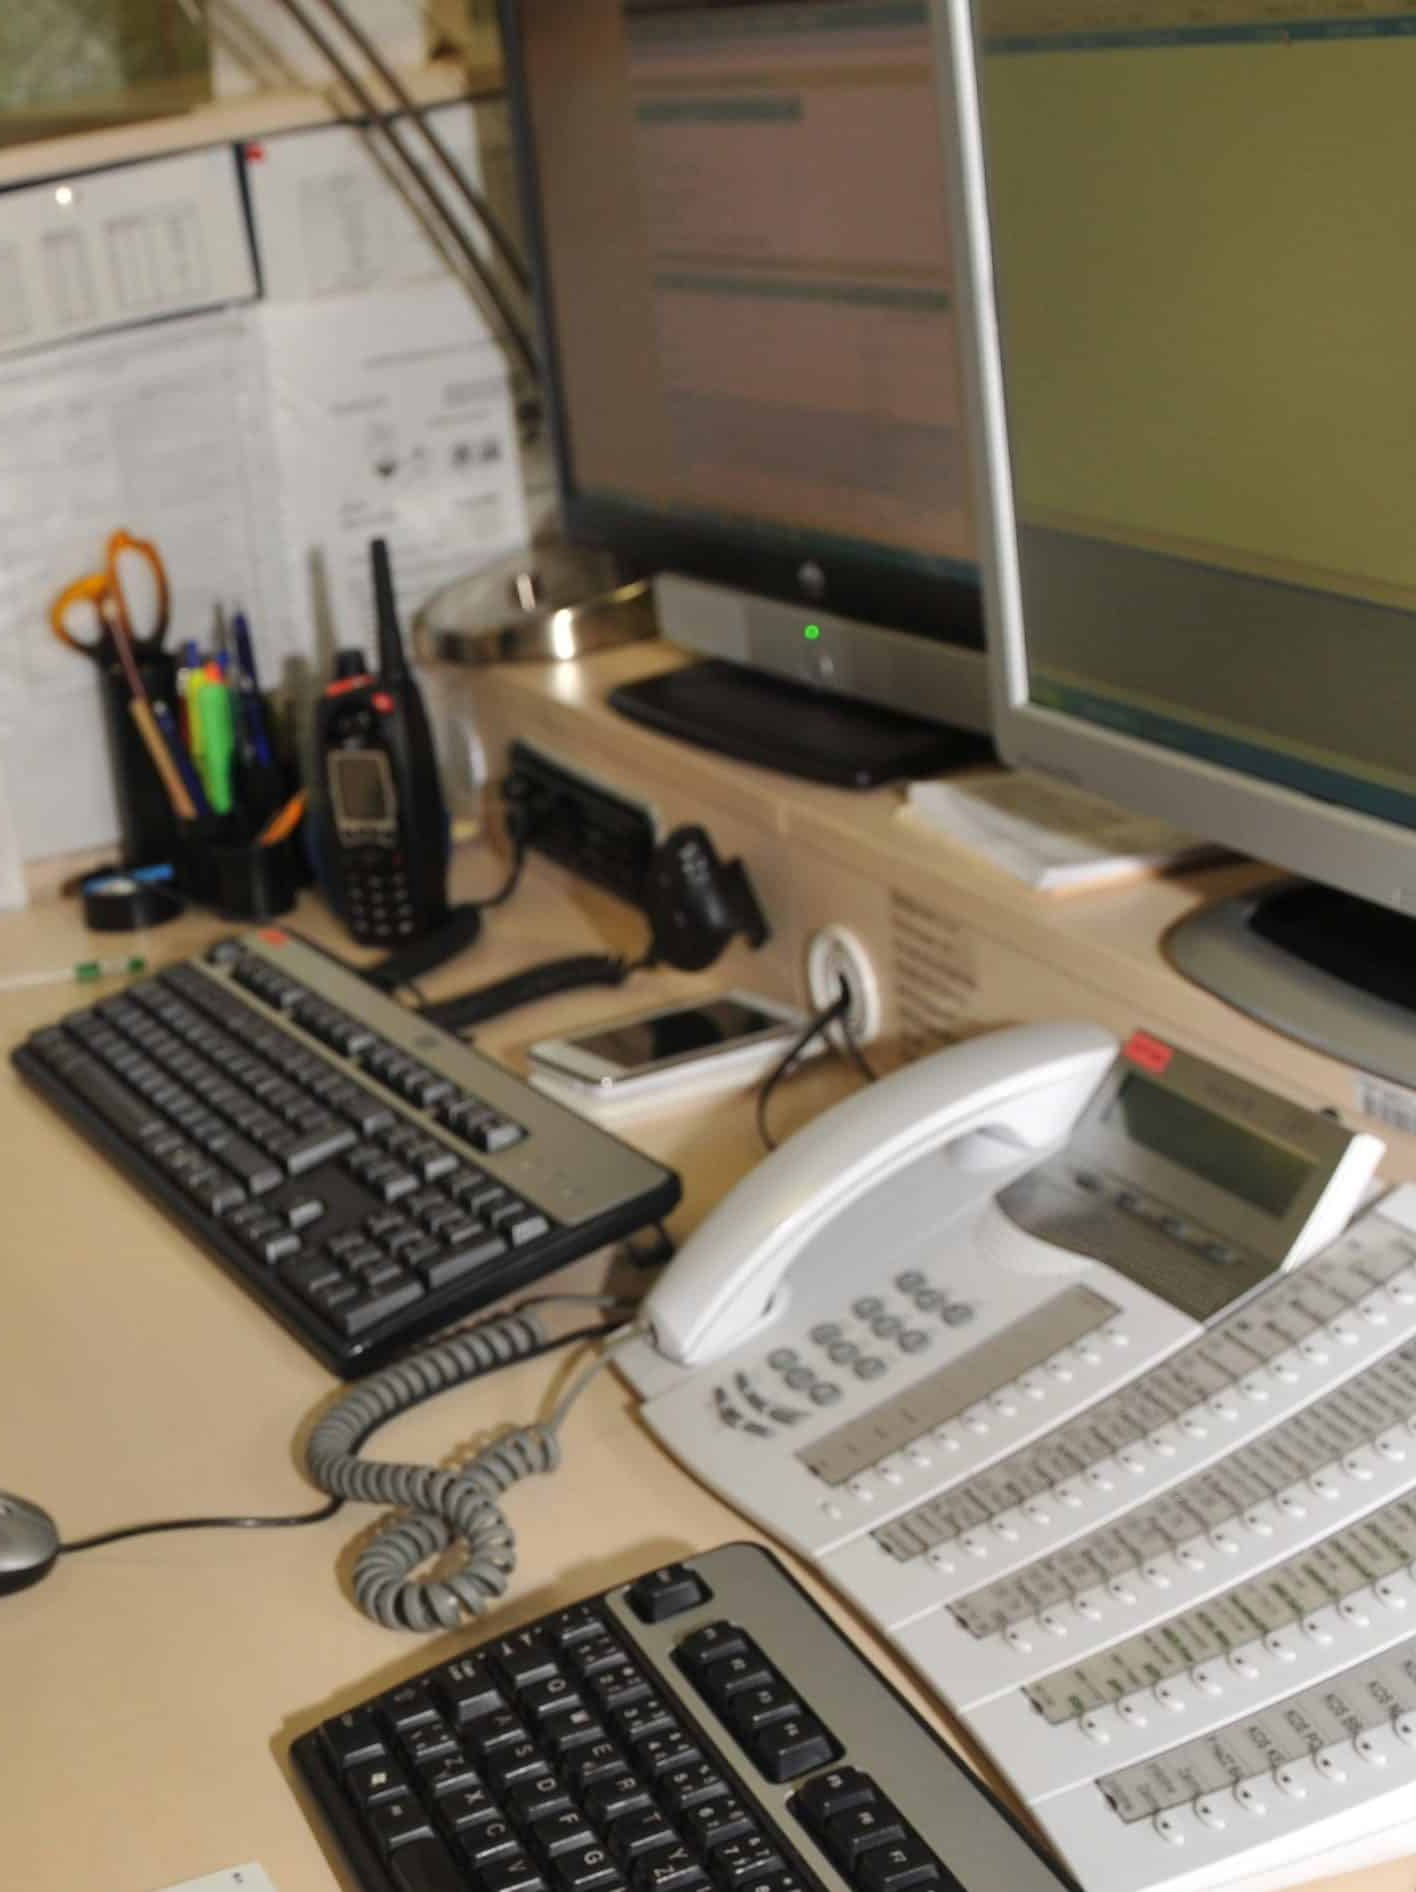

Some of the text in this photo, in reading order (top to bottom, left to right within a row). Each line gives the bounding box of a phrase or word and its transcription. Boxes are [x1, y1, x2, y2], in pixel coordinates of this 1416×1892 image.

[515, 1743, 534, 1758] S
[592, 1743, 613, 1757] E
[537, 1777, 558, 1792] D
[615, 1776, 636, 1791] R
[559, 1811, 580, 1826] F
[486, 1822, 506, 1838] C
[584, 1849, 604, 1866] G
